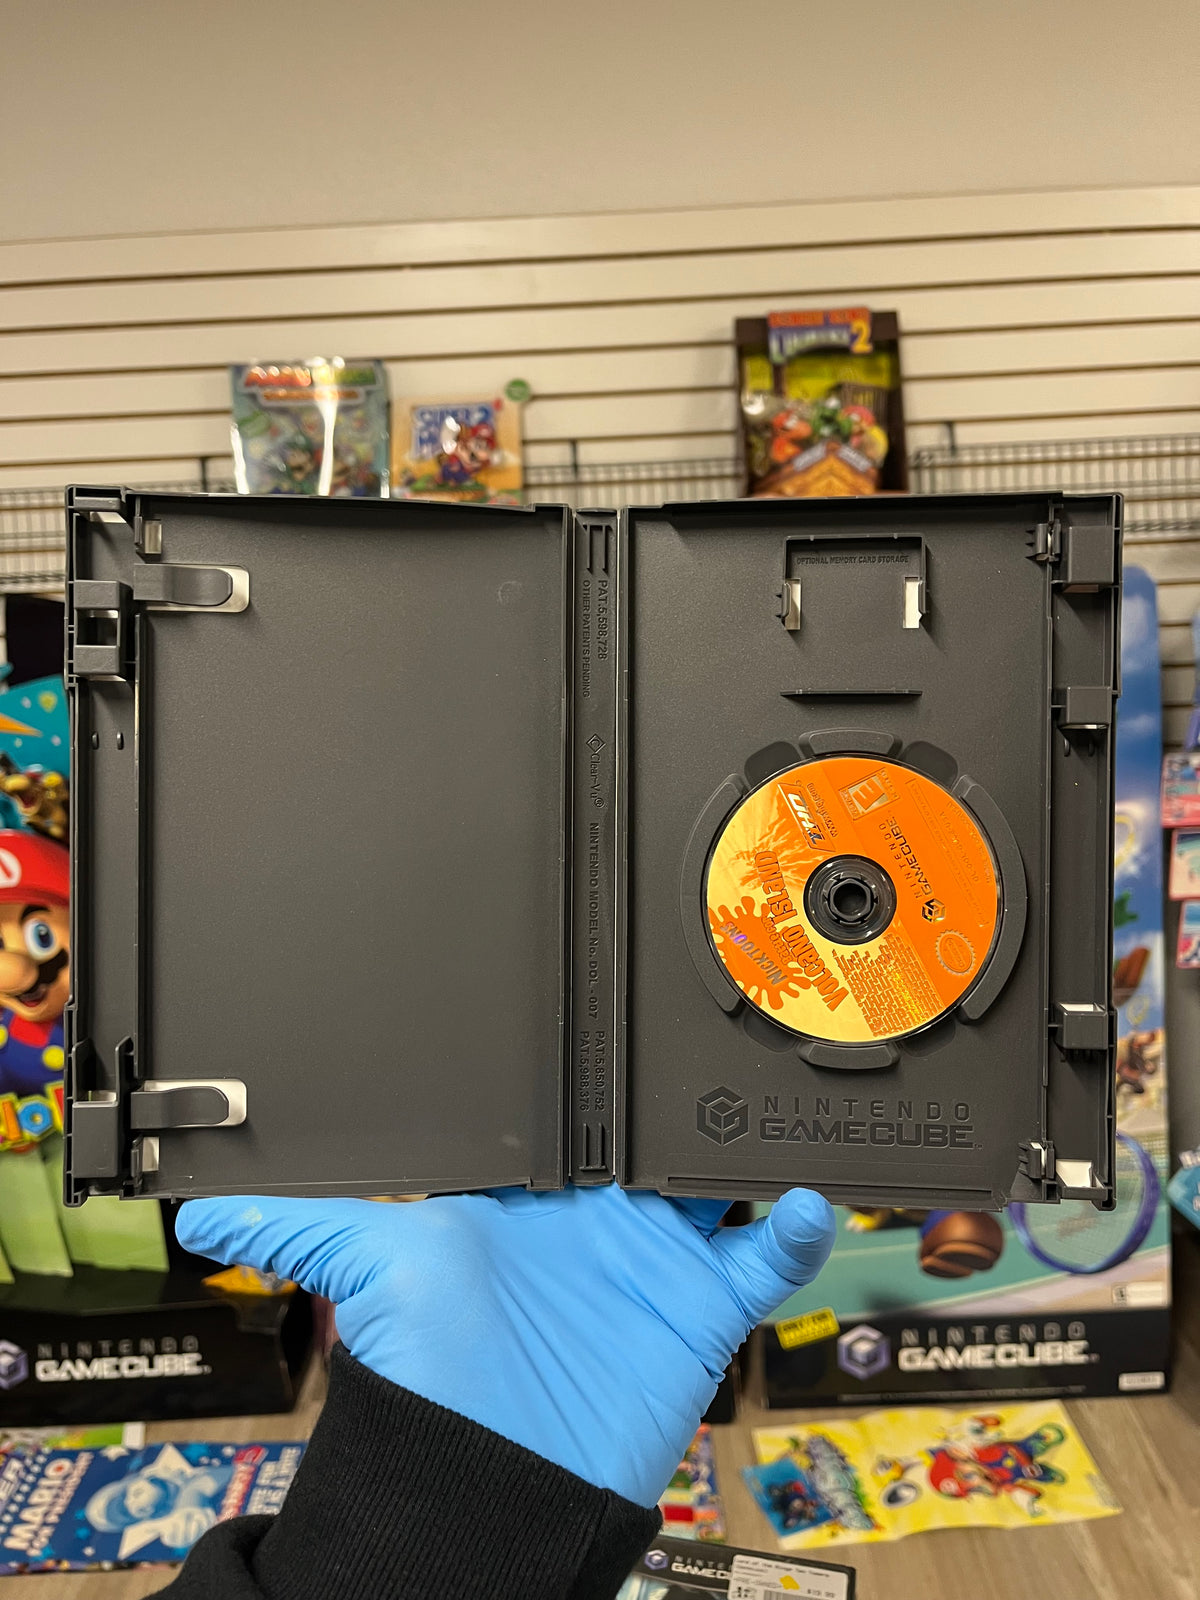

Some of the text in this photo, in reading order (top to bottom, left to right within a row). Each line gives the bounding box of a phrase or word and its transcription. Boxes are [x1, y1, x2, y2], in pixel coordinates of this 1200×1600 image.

[797, 554, 909, 565] OPTIONAL MEMORY CARD STORAGE
[582, 580, 592, 698] OTHER PATENTS PENDING
[589, 823, 600, 888] NINTENDO
[878, 822, 922, 899] NINTENDO
[886, 816, 933, 896] GAMECUBE
[589, 891, 599, 934] MODEL
[589, 938, 599, 958] No.
[720, 921, 788, 986] NICKTOONS
[764, 1095, 970, 1123] NINTENDO
[759, 1117, 975, 1150] GAMECUBE
[37, 1335, 199, 1358] NINTENDO
[901, 1321, 1086, 1347] NINTENDO
[35, 1352, 203, 1382] GAMECUBE
[898, 1340, 1090, 1372] GAMECUBE
[3, 1457, 74, 1551] MARIO
